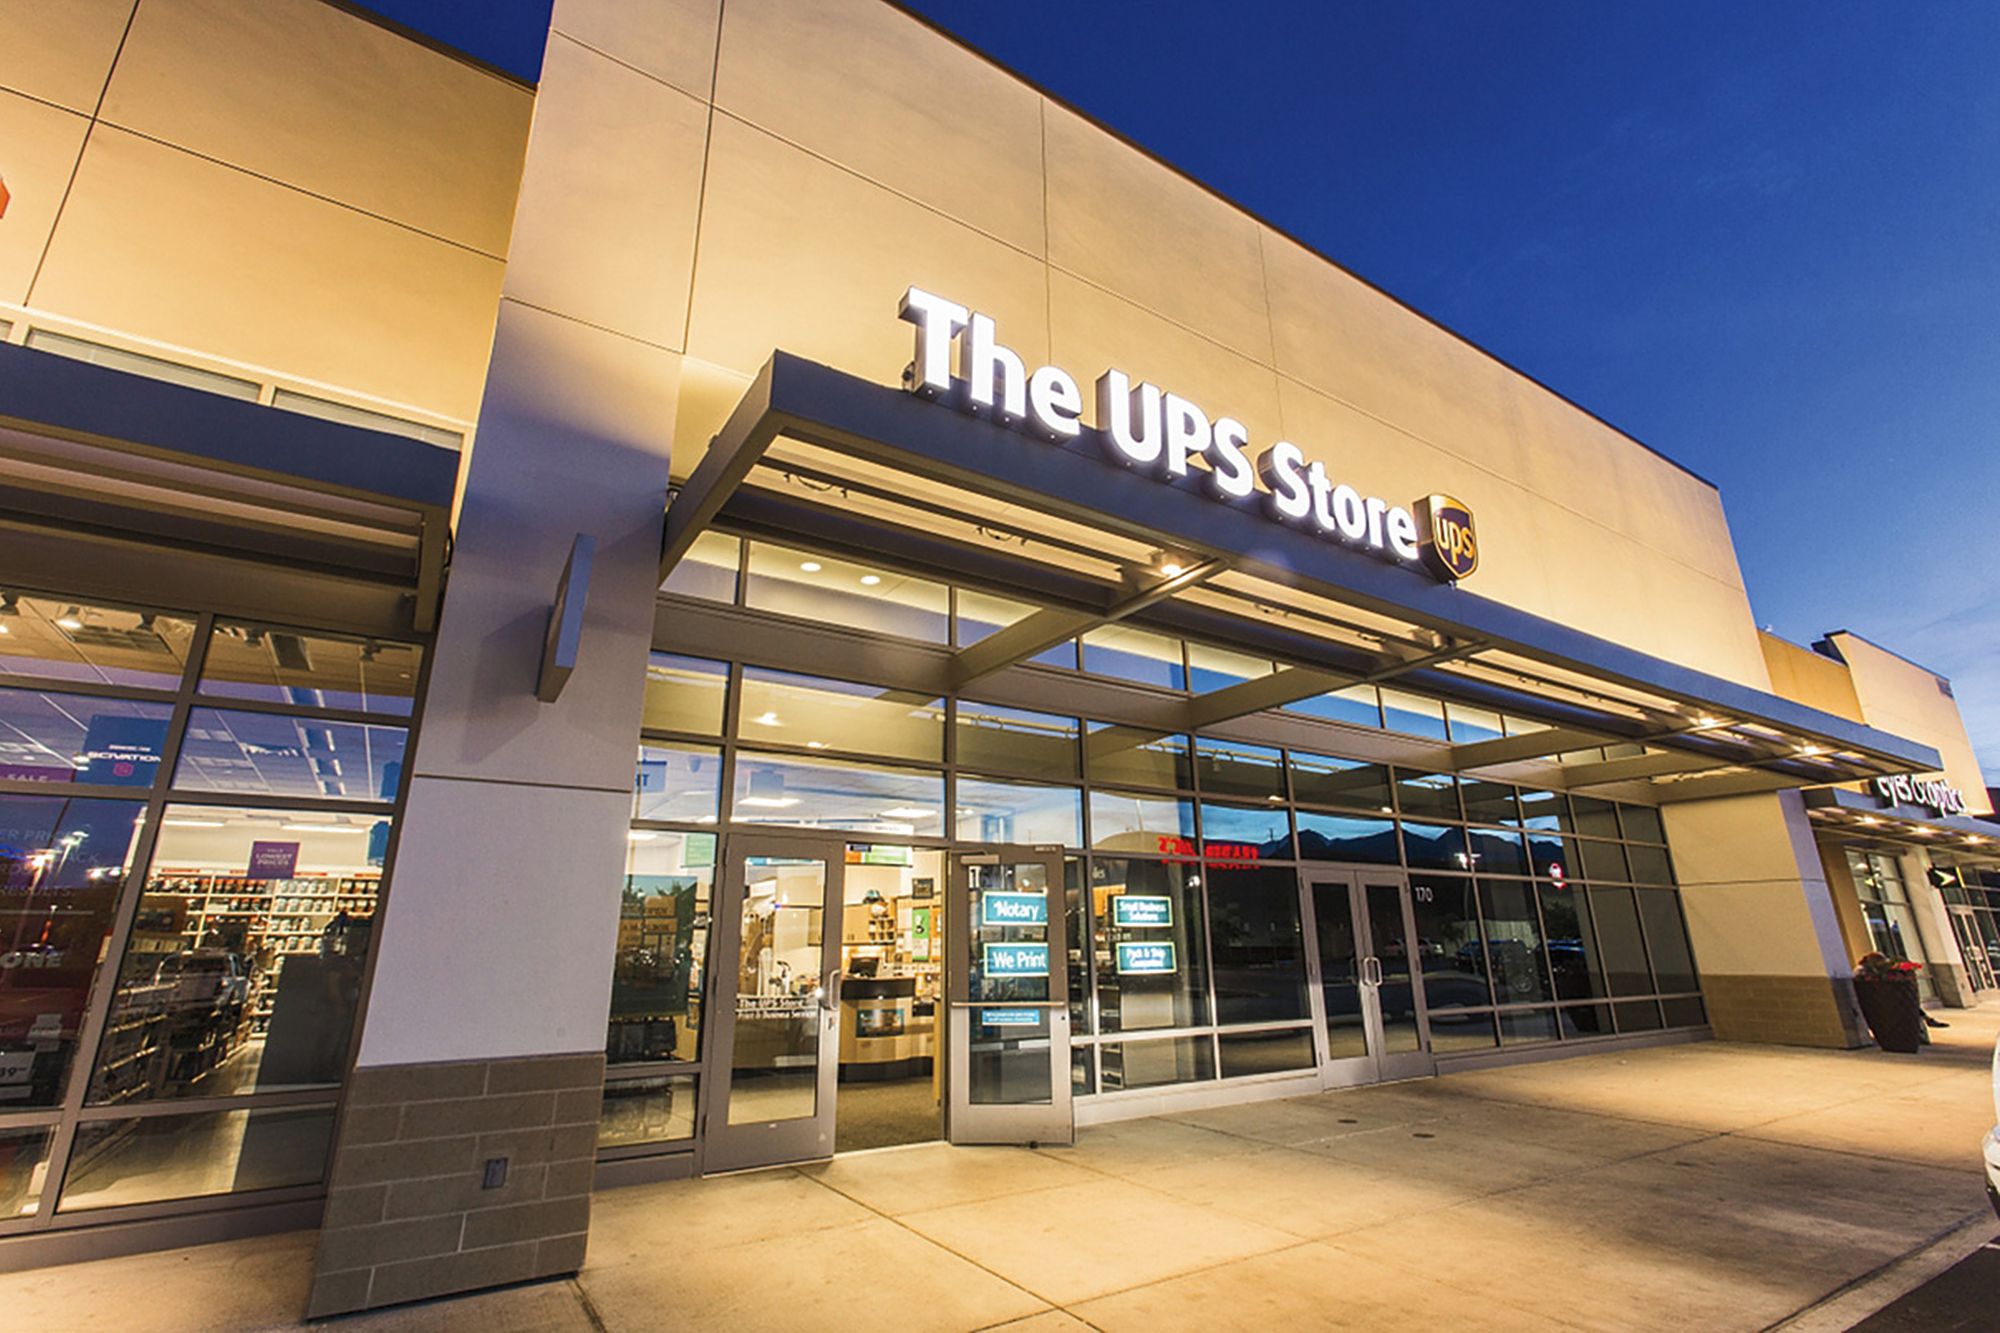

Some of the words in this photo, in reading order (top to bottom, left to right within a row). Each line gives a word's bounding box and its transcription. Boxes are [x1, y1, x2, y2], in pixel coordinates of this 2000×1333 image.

[900, 285, 1082, 437] The
[1097, 368, 1255, 498] UPS
[1259, 440, 1420, 560] Store
[1435, 515, 1476, 566] ups
[995, 900, 1039, 921] Notary
[993, 951, 1015, 969] We
[1017, 951, 1047, 969] Print
